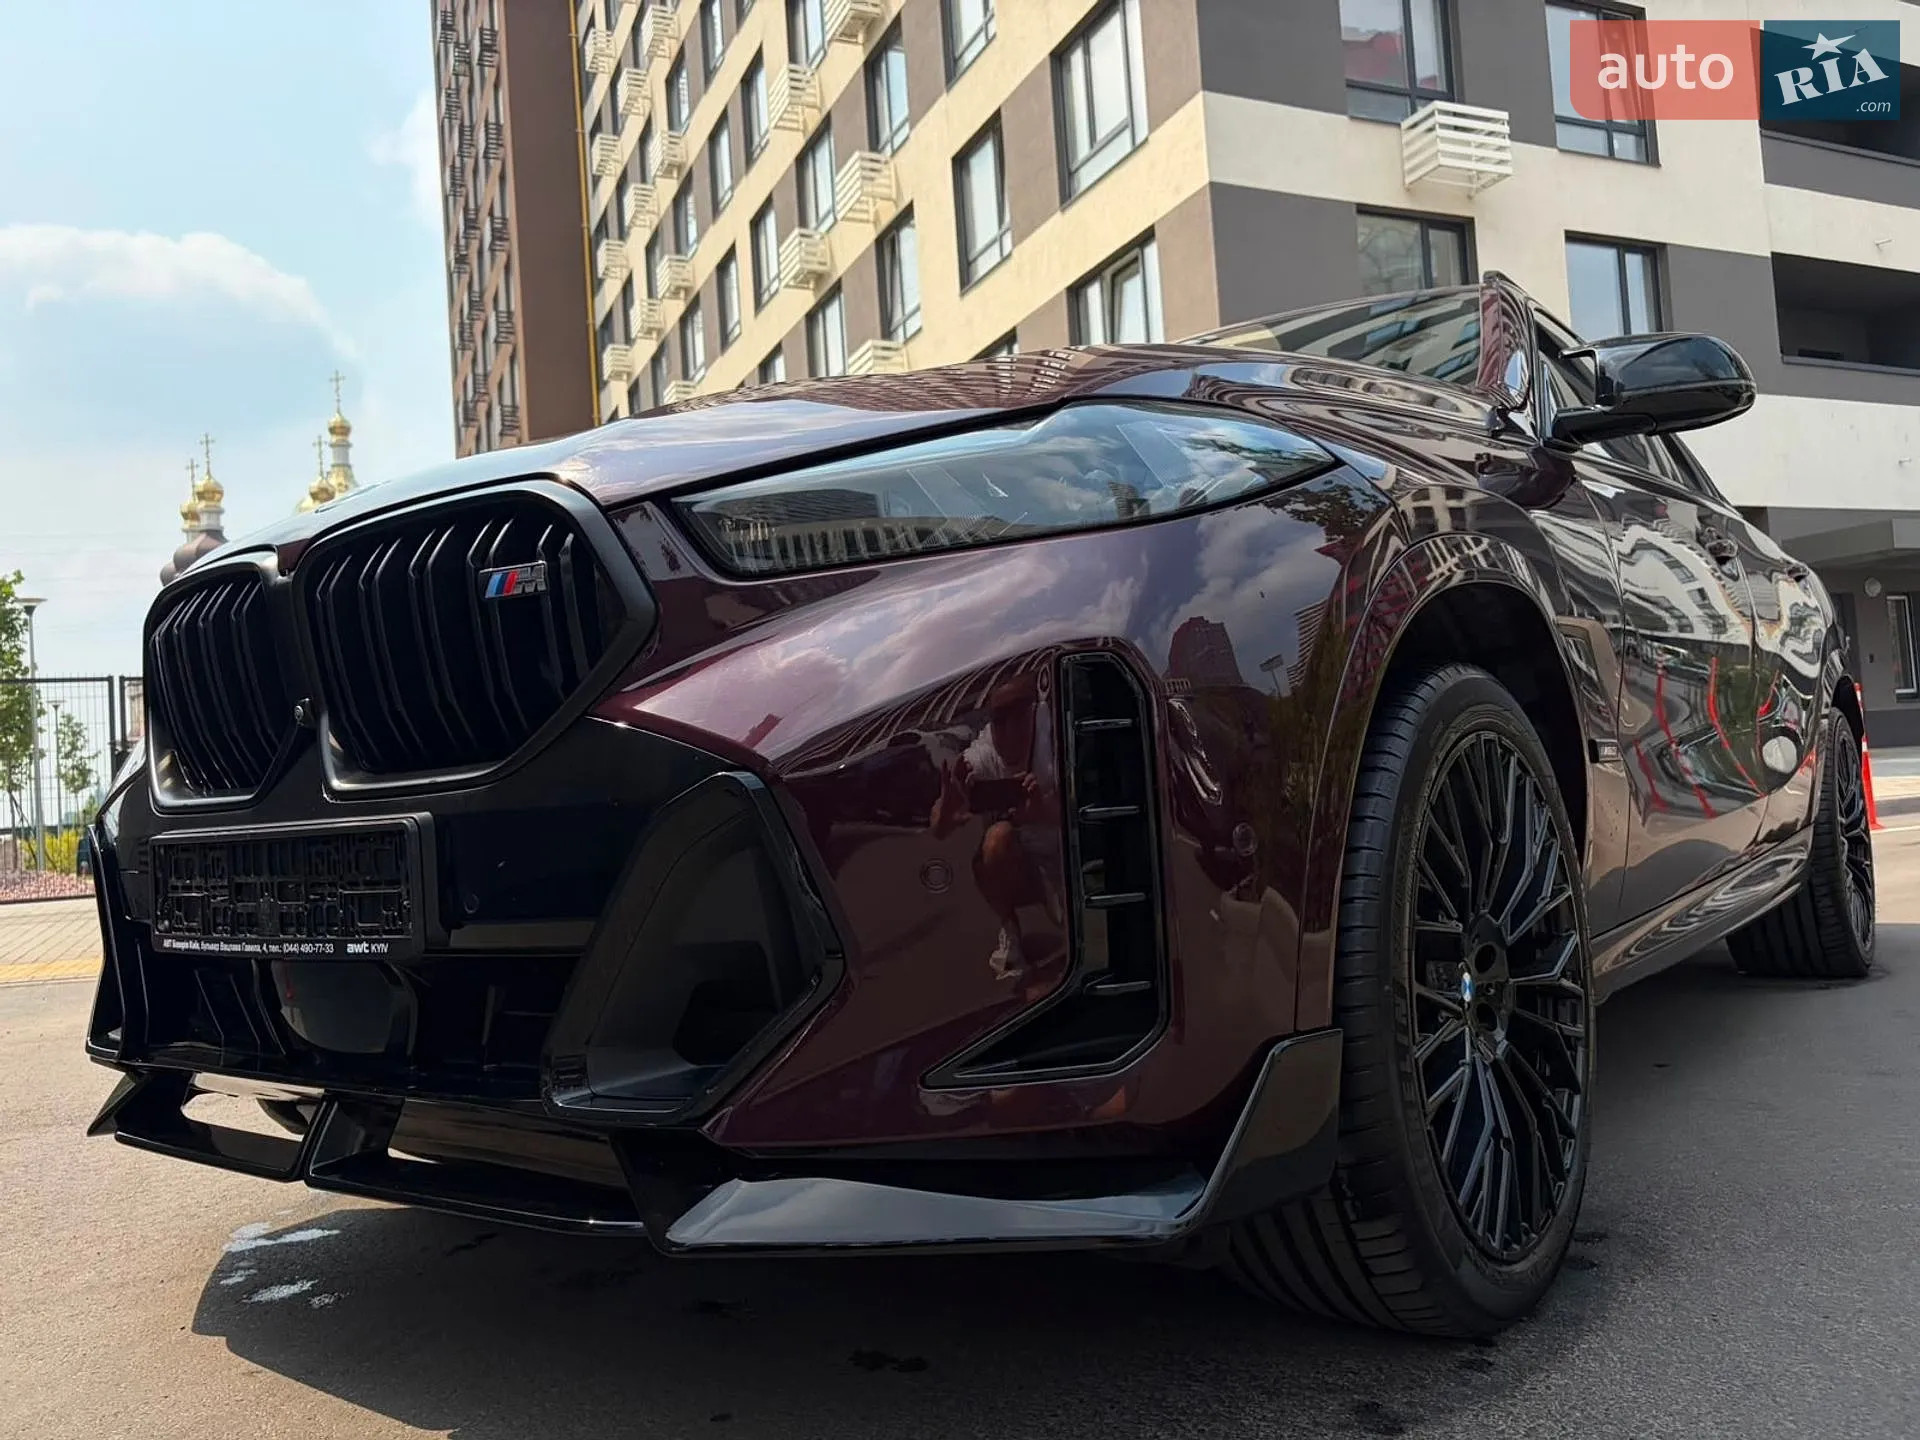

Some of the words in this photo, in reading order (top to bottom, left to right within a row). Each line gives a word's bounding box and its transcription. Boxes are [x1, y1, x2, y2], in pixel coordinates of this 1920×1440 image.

[283, 943, 299, 954] (044)
[300, 943, 334, 953] 490-77-33
[347, 941, 369, 953] awt
[371, 942, 388, 953] KYIV
